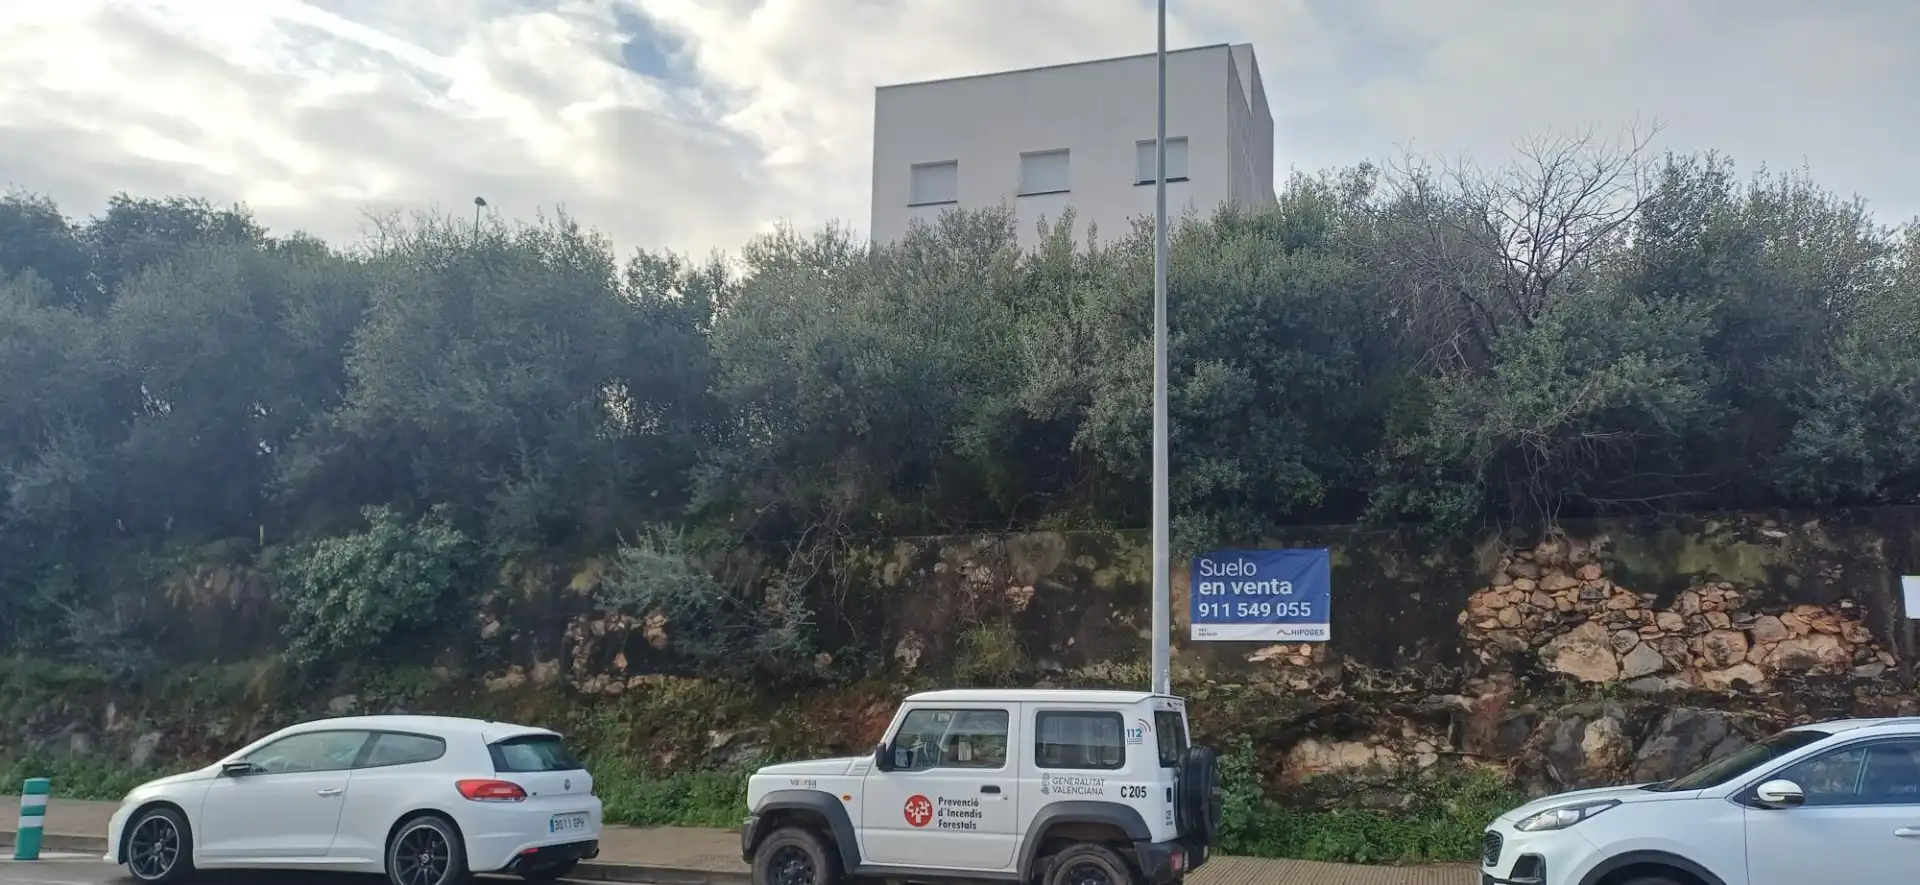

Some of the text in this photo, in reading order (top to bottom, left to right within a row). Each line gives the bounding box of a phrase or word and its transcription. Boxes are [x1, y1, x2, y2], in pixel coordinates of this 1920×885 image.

[1200, 558, 1257, 577] Suelo
[1199, 578, 1292, 595] en venta
[1199, 602, 1311, 617] 911 549 055
[1126, 728, 1143, 738] 112
[1052, 777, 1105, 786] GENERALITAT
[1053, 785, 1104, 796] VALENCIANA
[1120, 786, 1147, 799] C 205
[938, 797, 979, 808] Prevenció
[938, 819, 977, 830] Forestals
